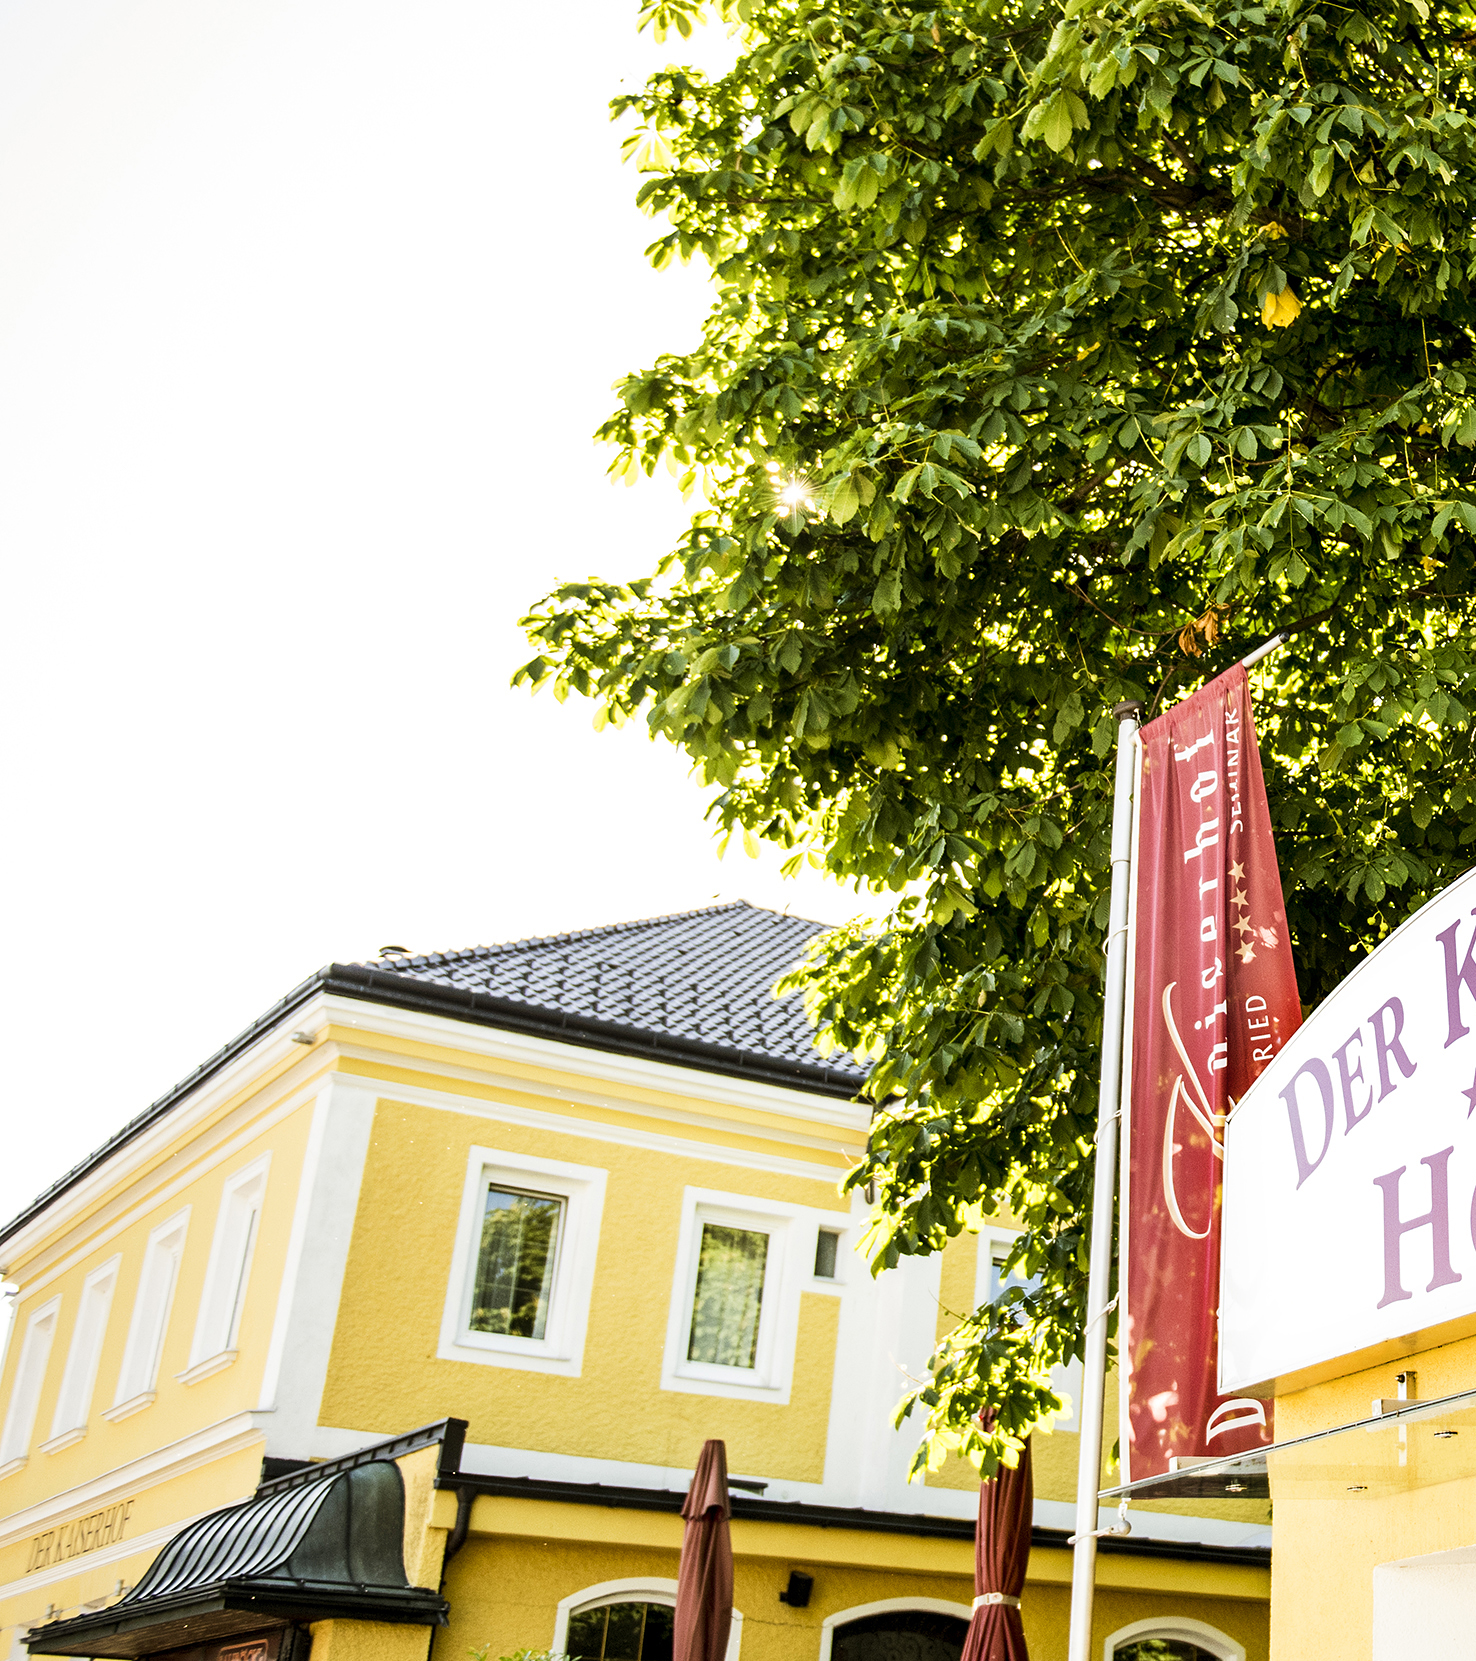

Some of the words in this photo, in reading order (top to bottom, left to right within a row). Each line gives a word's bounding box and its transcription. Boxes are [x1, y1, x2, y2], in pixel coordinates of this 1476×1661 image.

[1246, 994, 1274, 1061] RIED
[1278, 995, 1417, 1191] DER
[26, 1530, 54, 1573] DER
[53, 1499, 135, 1562] KAISERHOF
